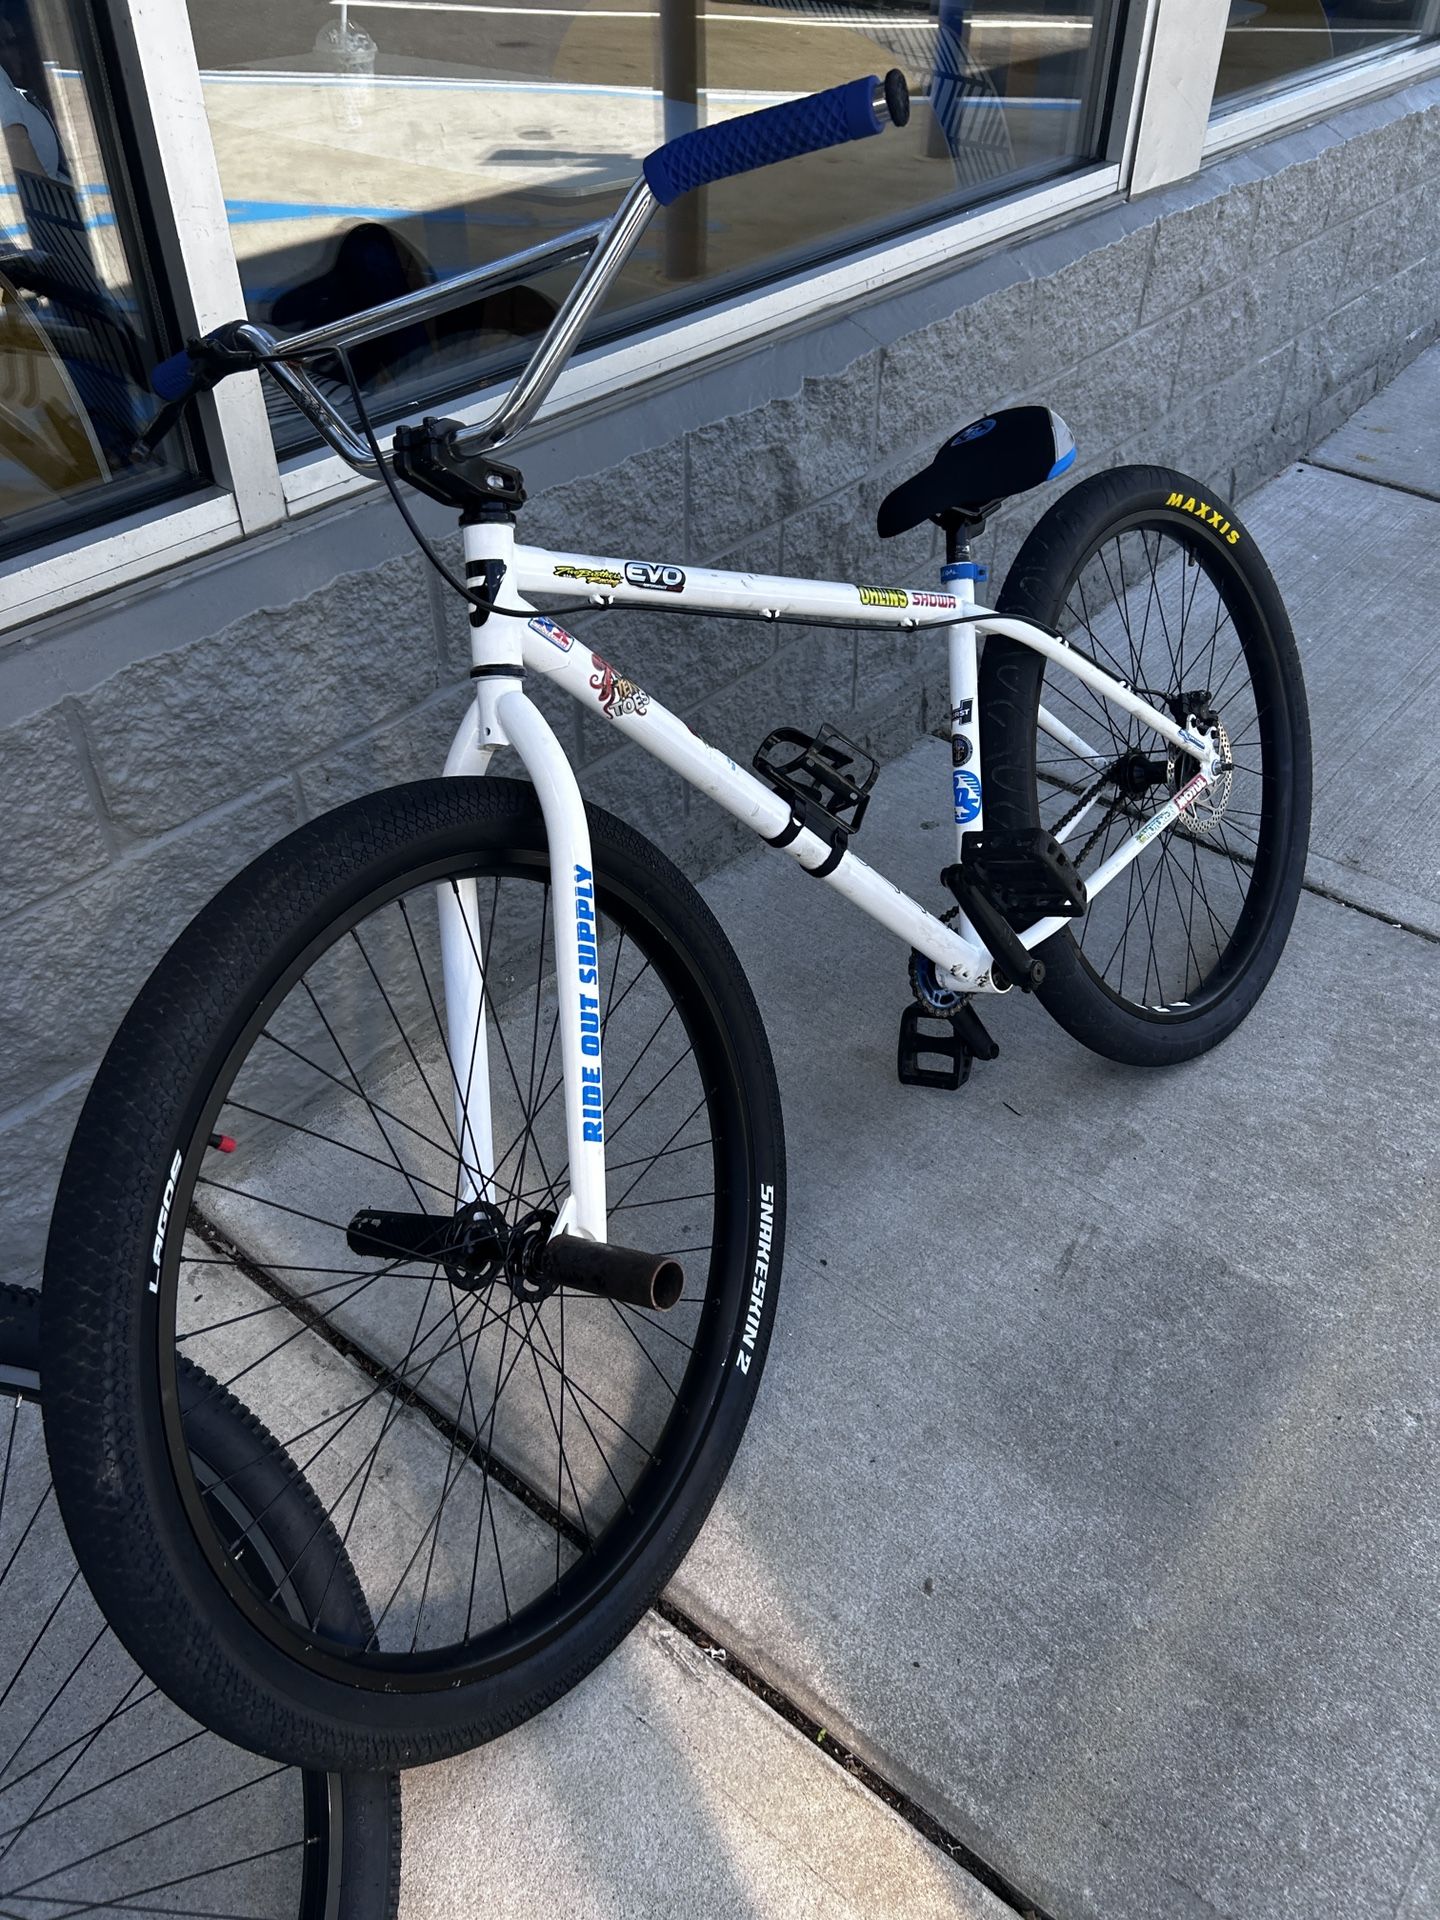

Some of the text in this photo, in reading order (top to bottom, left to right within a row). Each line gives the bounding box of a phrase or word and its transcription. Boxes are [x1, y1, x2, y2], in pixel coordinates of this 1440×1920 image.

[1166, 492, 1240, 544] MAXXIS
[625, 562, 680, 586] EVO
[911, 592, 957, 609] SHOWA
[609, 691, 650, 717] TOES
[1177, 777, 1208, 810] MOTUL
[573, 864, 603, 1143] RIDE OUT SUPPLY
[148, 1149, 183, 1295] LAGOS
[735, 1183, 774, 1375] SNAKESKIN 2
